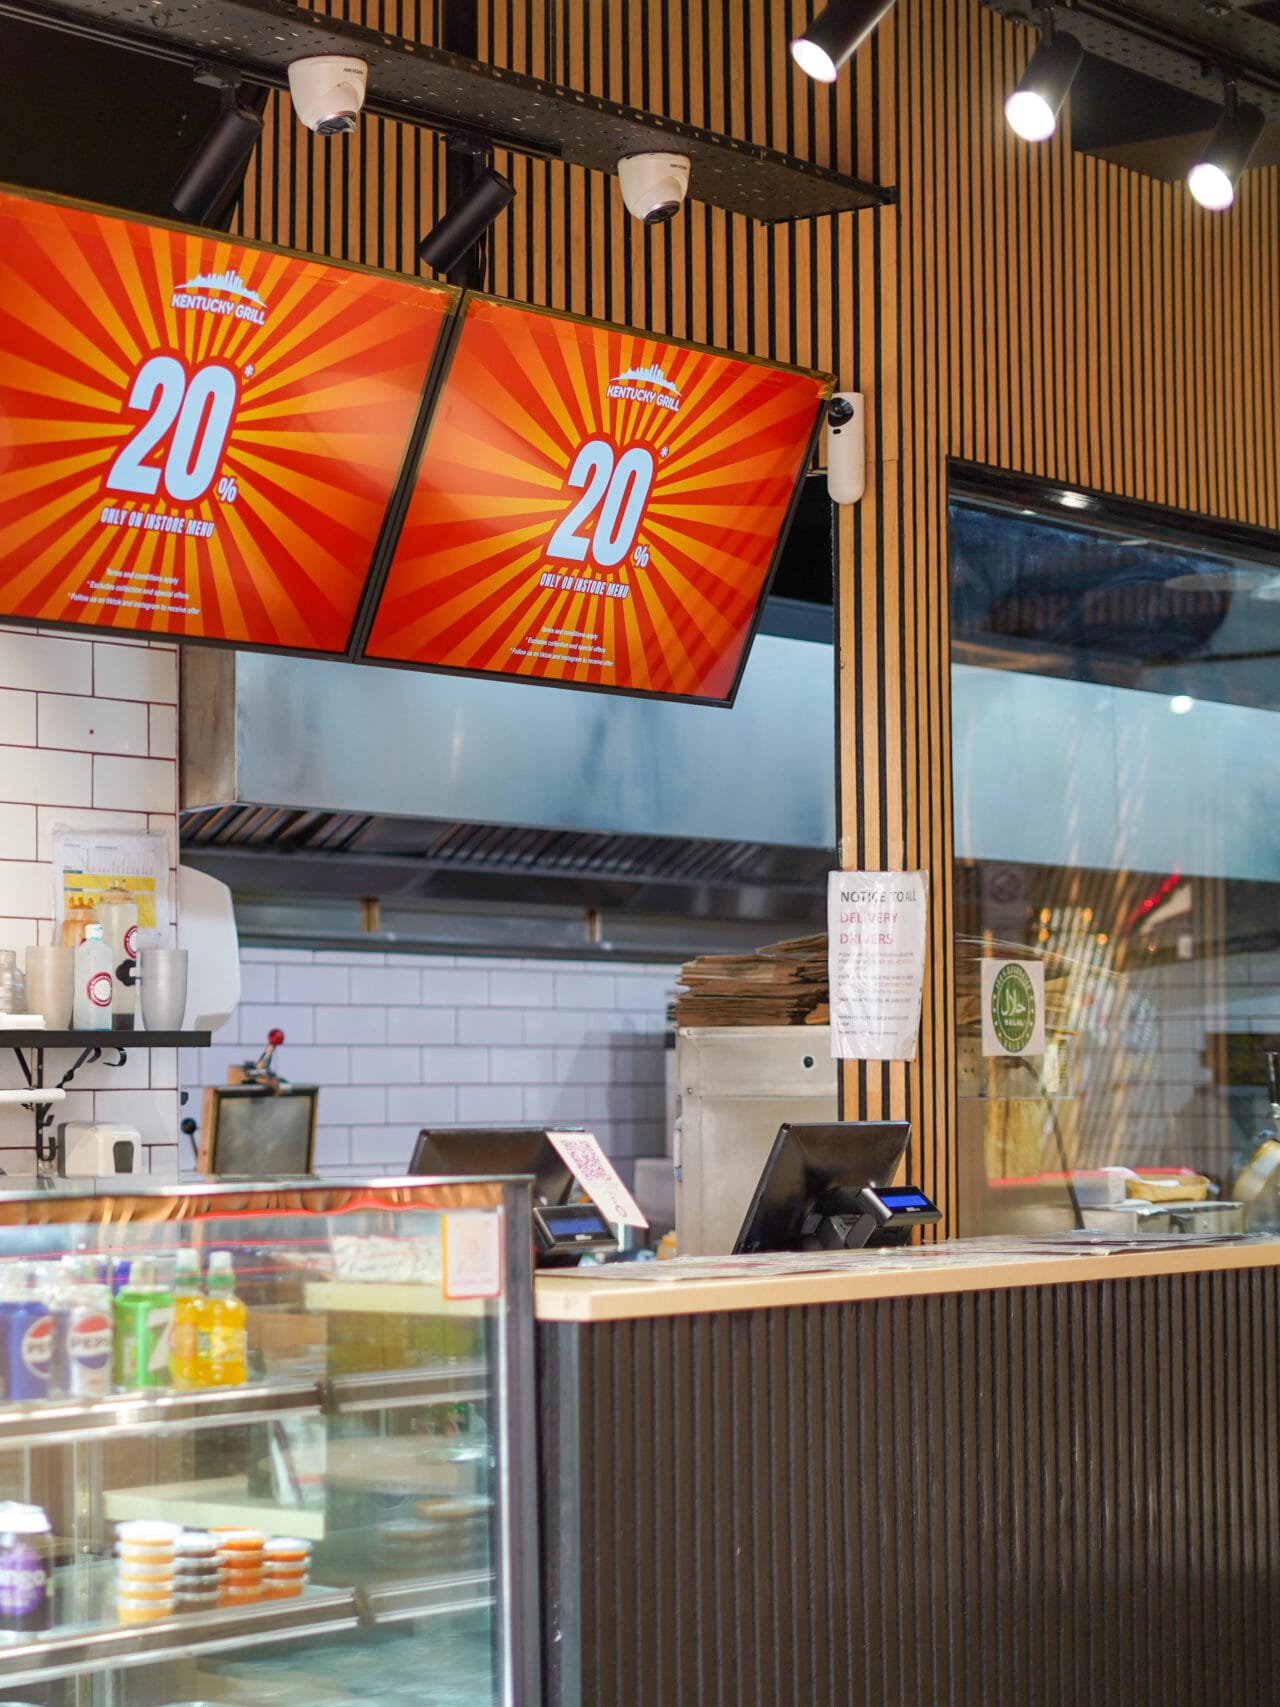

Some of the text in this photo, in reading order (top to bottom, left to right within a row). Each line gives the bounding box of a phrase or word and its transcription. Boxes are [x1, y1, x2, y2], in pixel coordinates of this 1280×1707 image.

[170, 293, 266, 326] KENTUCKY GRILL
[606, 384, 681, 412] KENTUCKY GRILL
[106, 356, 236, 501] 20
[546, 440, 653, 566] 20
[100, 506, 215, 538] ONLY ON INSTORE MENU
[123, 570, 134, 579] and
[134, 571, 163, 582] conditions
[539, 572, 630, 598] ONLY ON INSTORE MENU
[905, 889, 917, 902] ALL
[840, 911, 898, 924] DELVERY
[1000, 988, 1027, 1017] حلال
